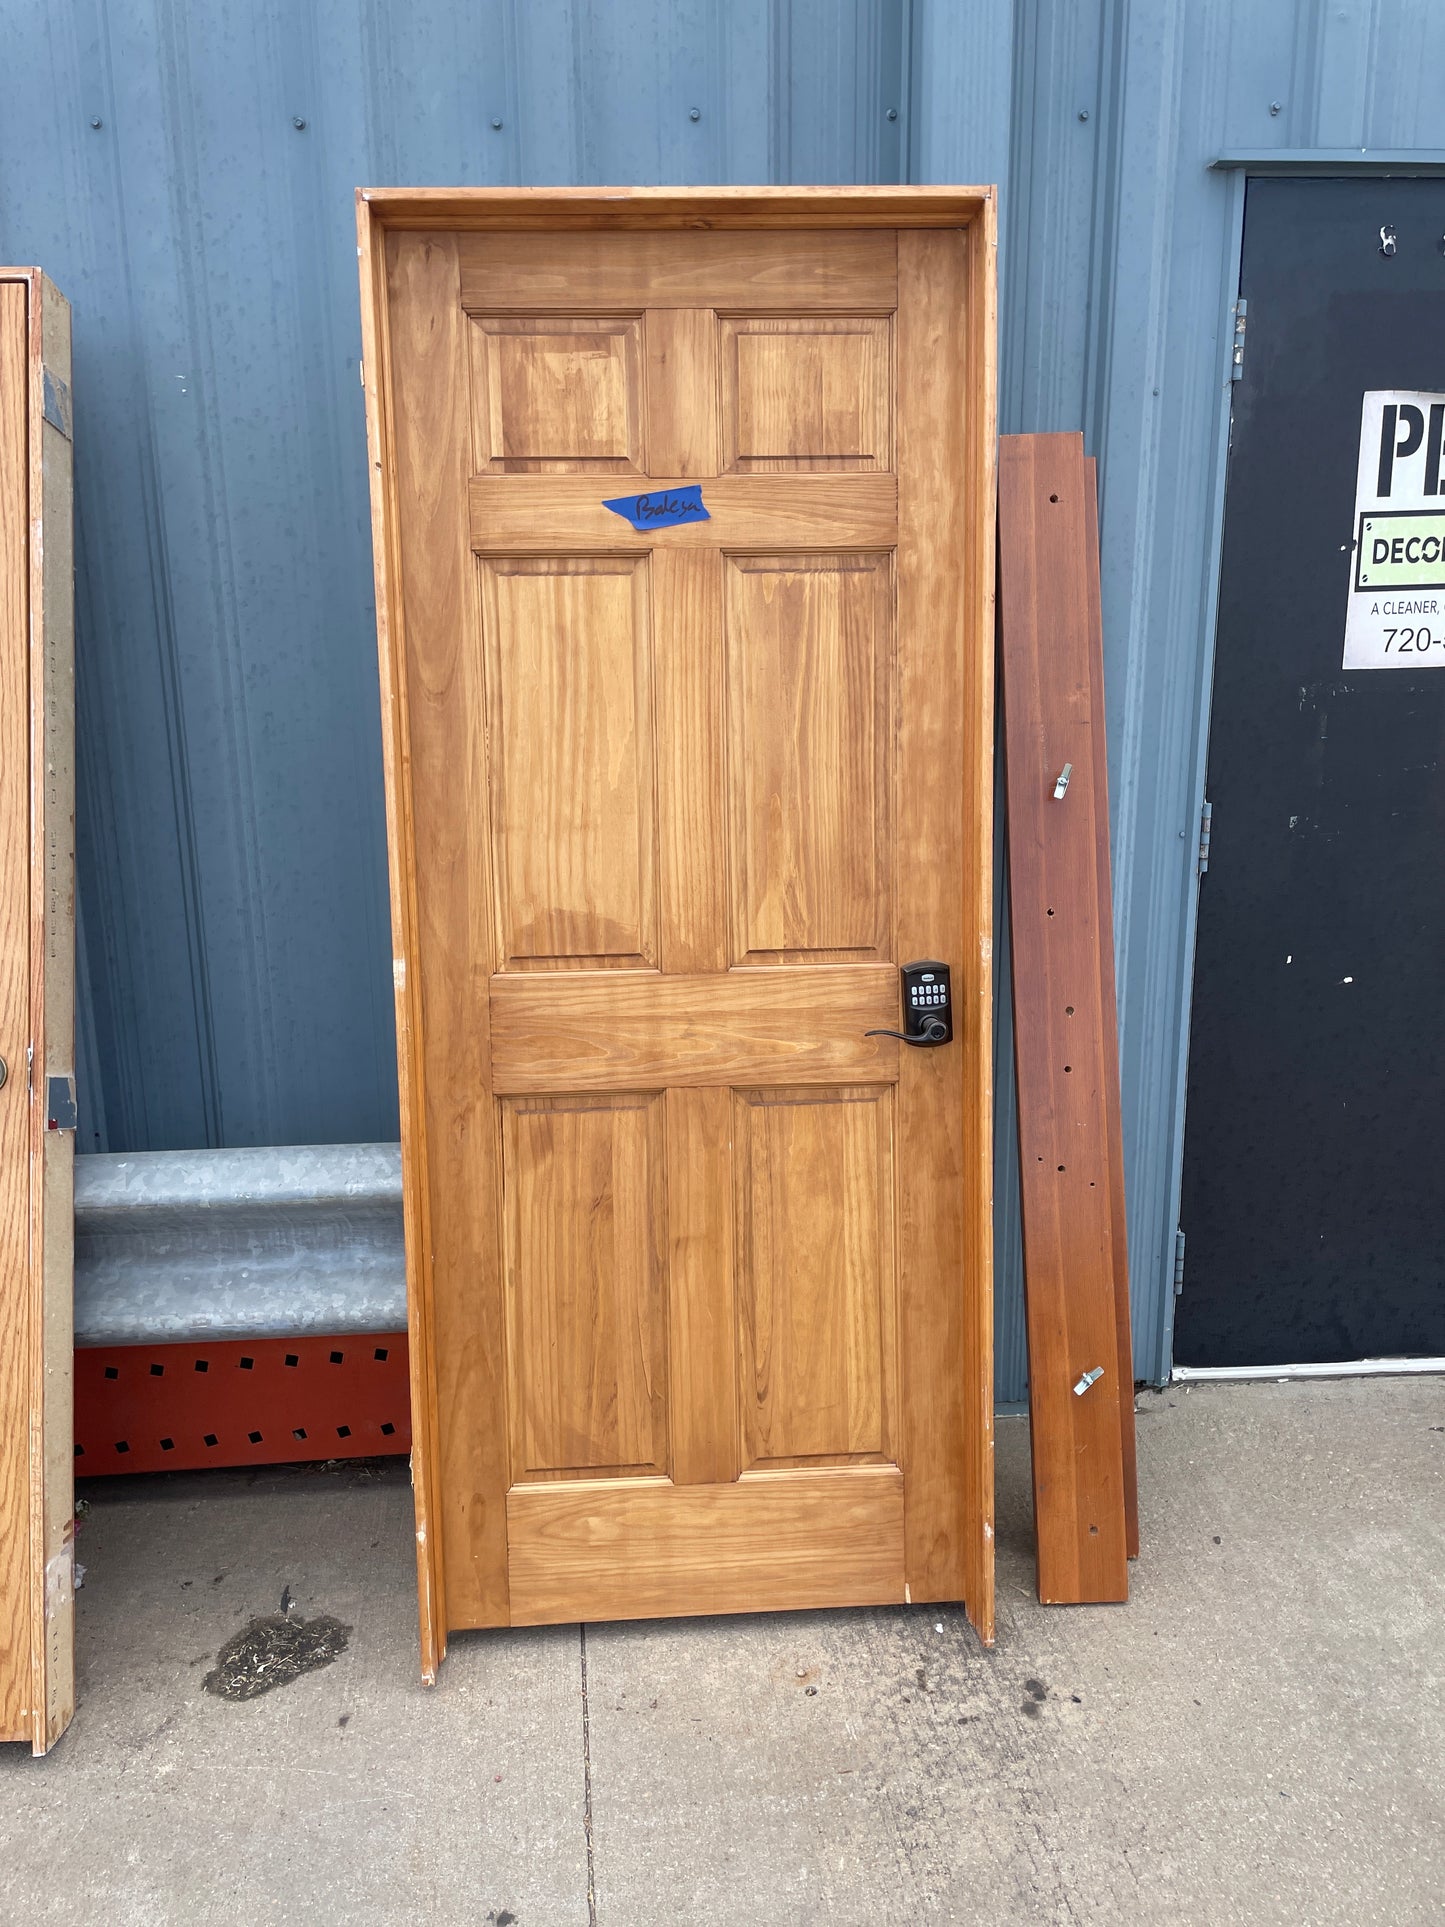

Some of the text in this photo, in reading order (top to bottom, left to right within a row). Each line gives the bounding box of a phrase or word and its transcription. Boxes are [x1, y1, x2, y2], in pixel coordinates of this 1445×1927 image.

[1372, 536, 1445, 565] DECO
[1371, 600, 1440, 615] A CLEANER,
[1382, 627, 1445, 652] 720-
